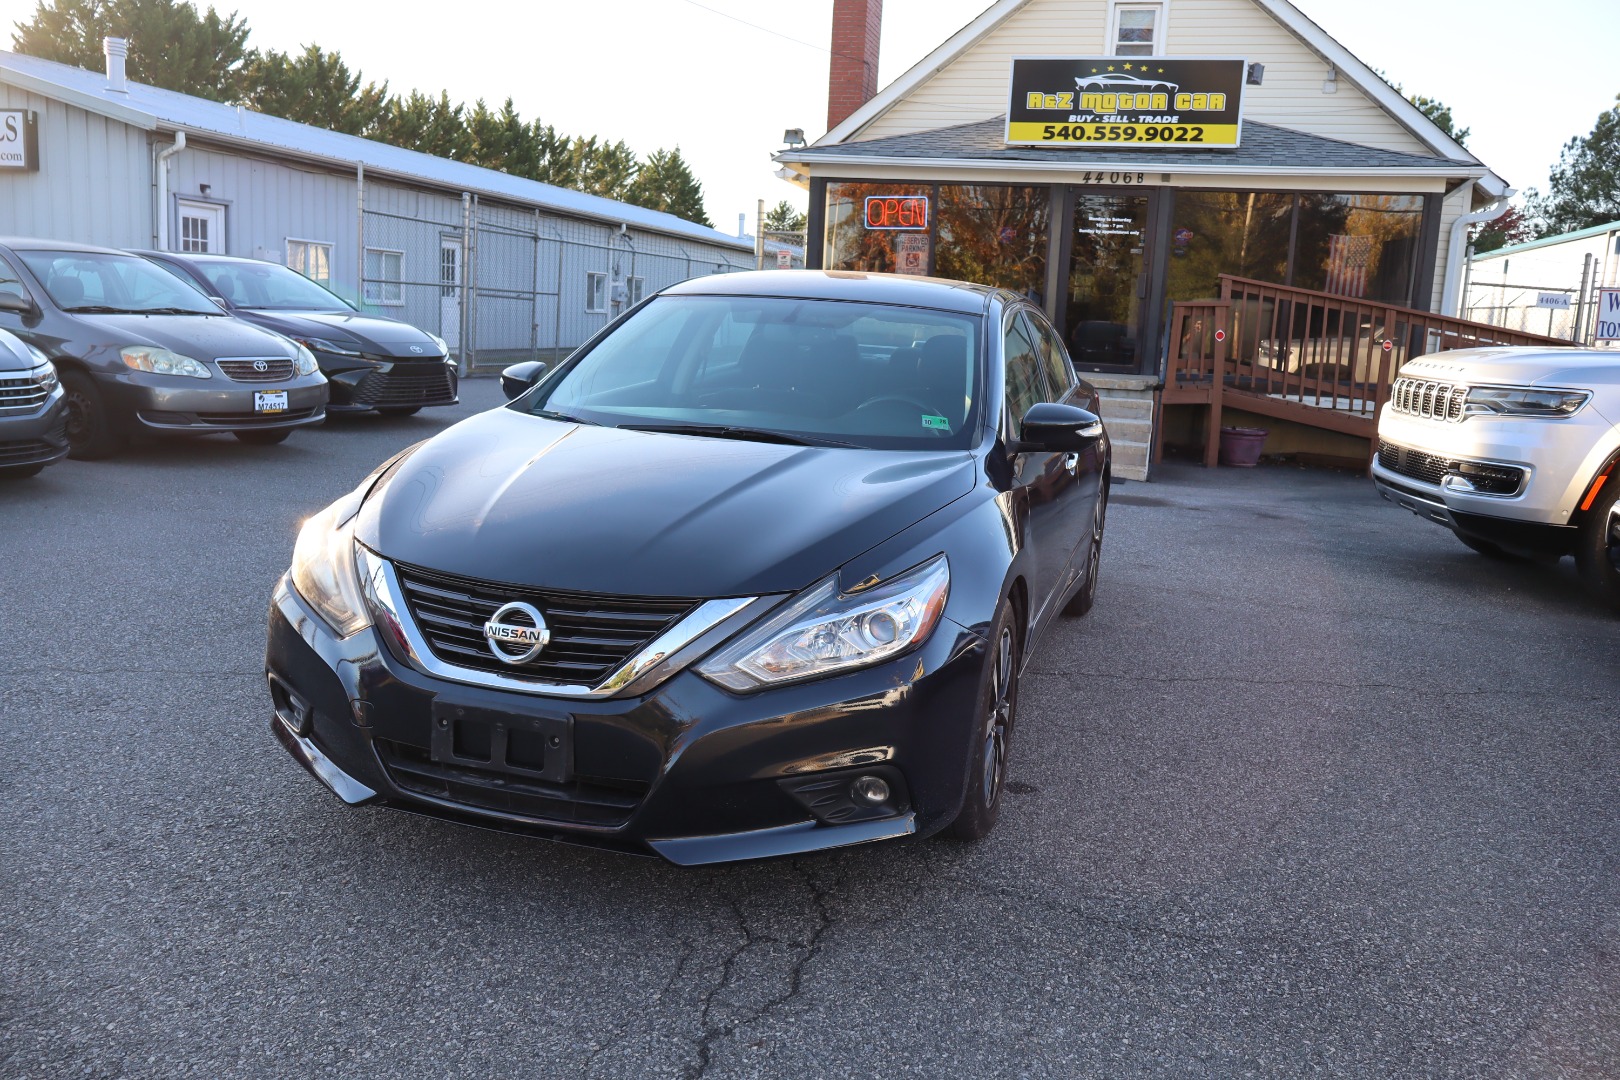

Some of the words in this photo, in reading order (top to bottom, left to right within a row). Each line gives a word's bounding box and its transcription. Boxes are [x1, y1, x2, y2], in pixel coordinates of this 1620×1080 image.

[1079, 91, 1168, 114] MOTOR
[1068, 114, 1095, 123] BUY
[1101, 115, 1129, 124] SELL
[1138, 115, 1180, 124] TRADE
[1042, 125, 1204, 142] 540.559.9022
[867, 199, 925, 226] OPEN
[488, 625, 541, 641] NISSAN
